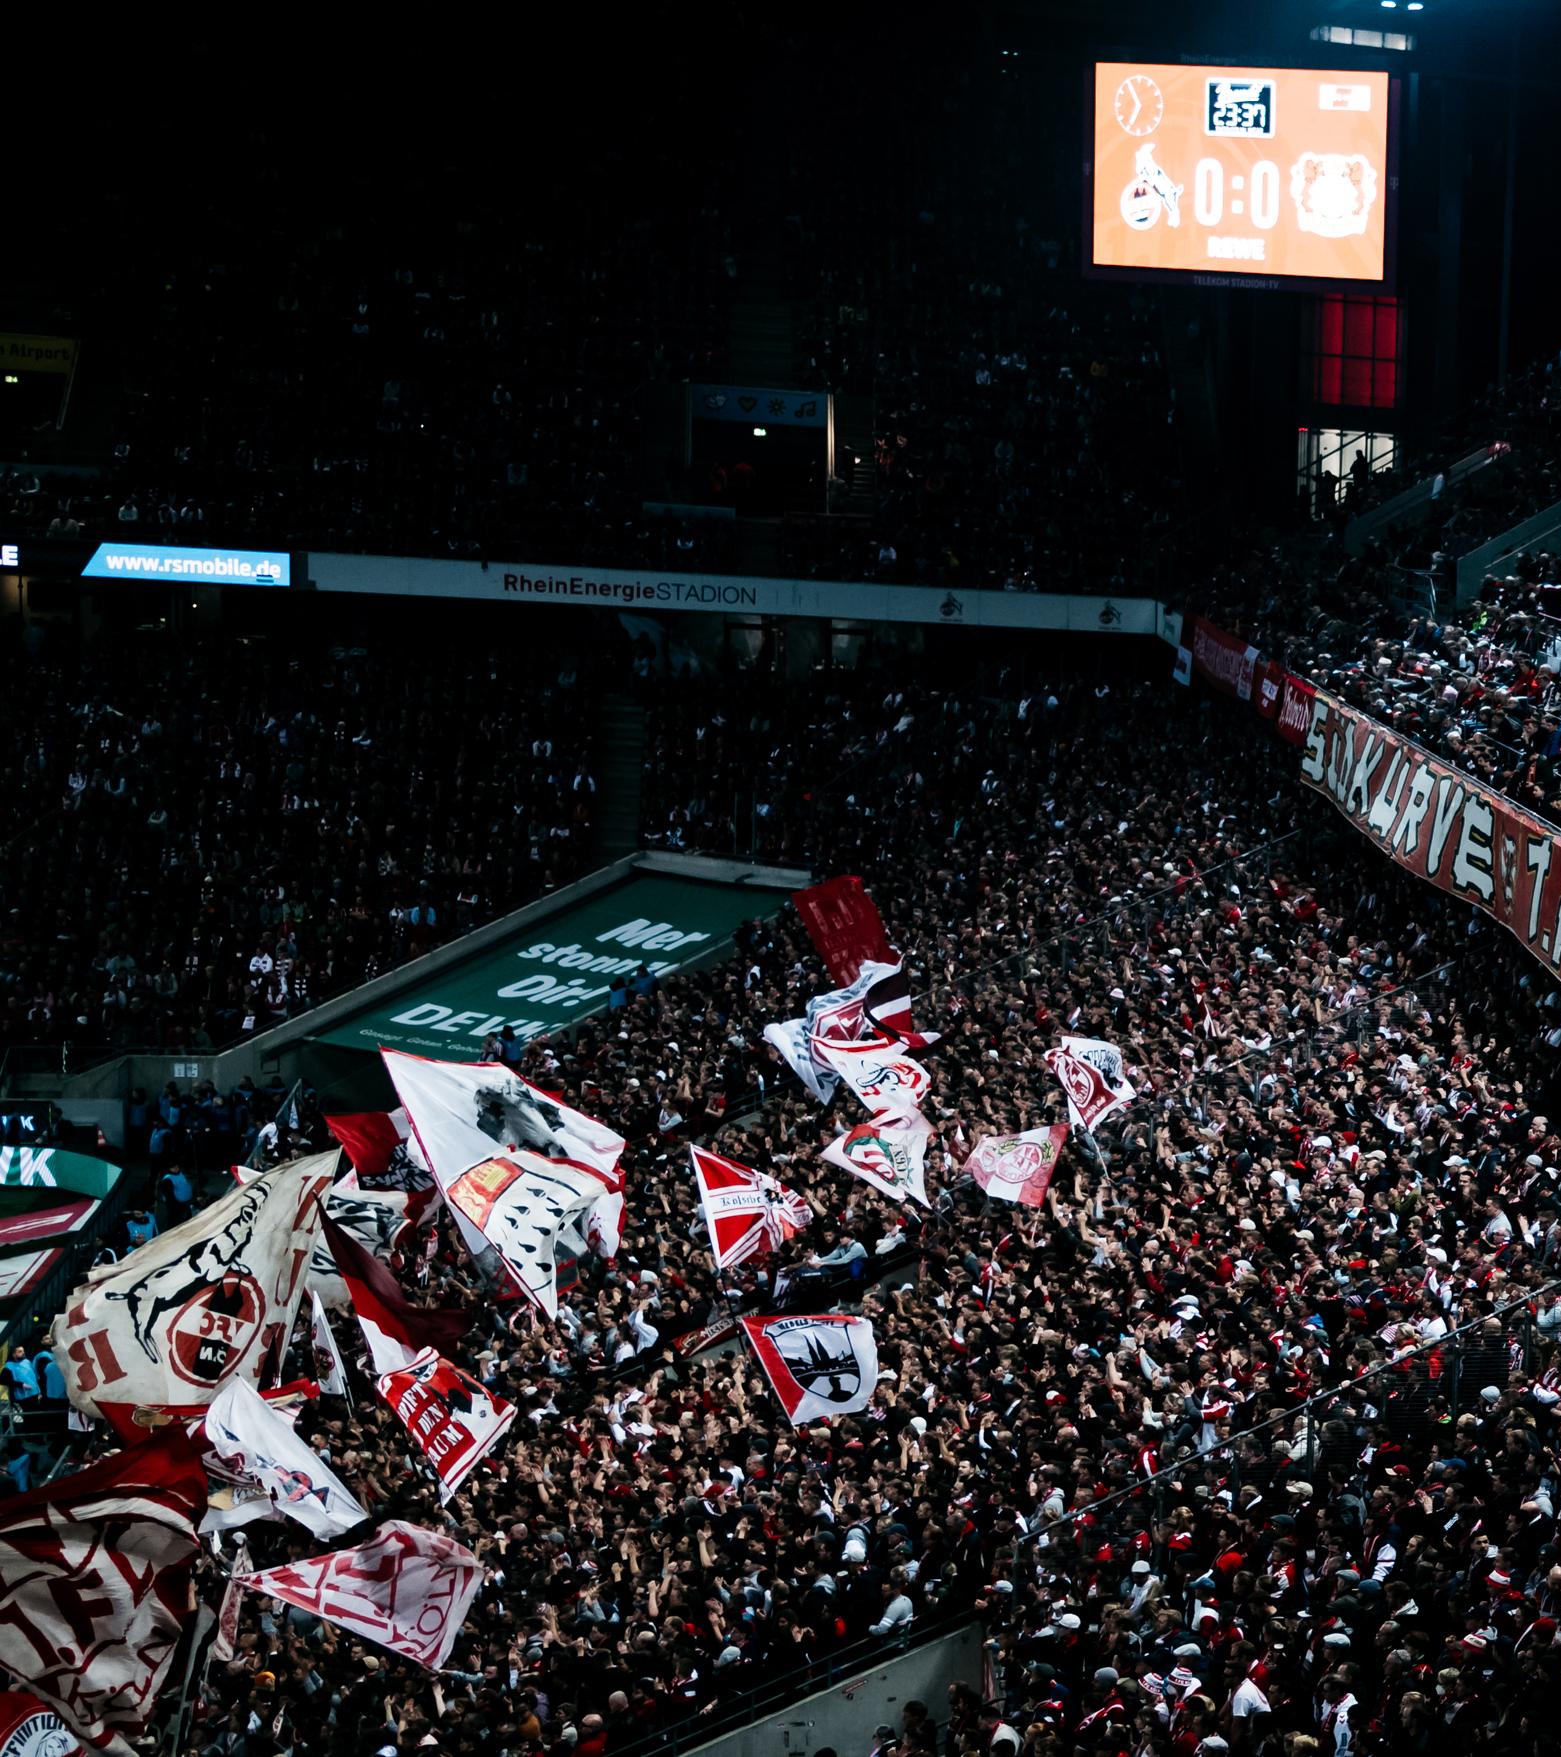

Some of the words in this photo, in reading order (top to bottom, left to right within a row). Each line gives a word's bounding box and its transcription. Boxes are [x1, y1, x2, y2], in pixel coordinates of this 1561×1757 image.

[1194, 157, 1280, 229] 0:0
[1193, 276, 1230, 288] TELEKOM
[9, 343, 70, 361] Airport
[106, 553, 281, 580] www.rsmobile.de
[503, 573, 757, 605] RheinEnergieSTADION
[595, 918, 711, 951] Mer
[518, 943, 643, 976] stonn
[497, 975, 610, 1007] Dir!
[418, 1403, 445, 1436] DEN
[427, 1424, 464, 1469] AUM
